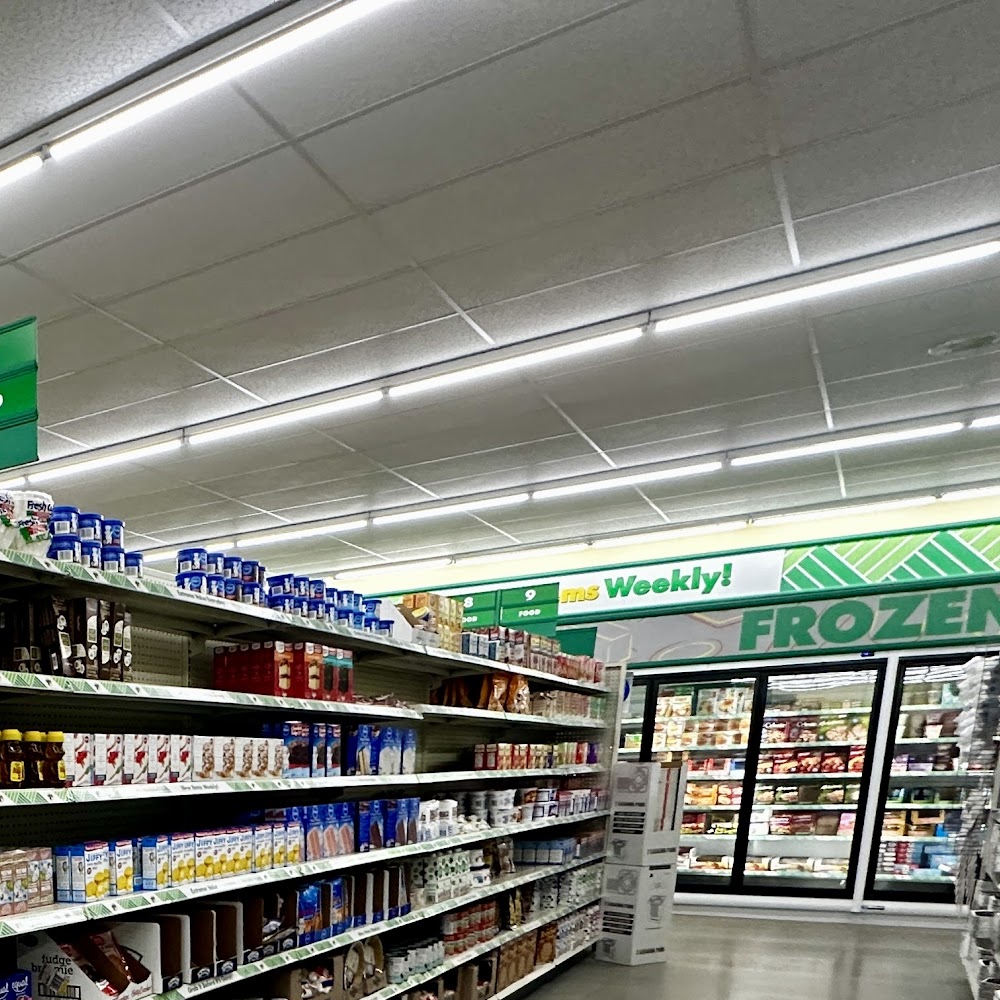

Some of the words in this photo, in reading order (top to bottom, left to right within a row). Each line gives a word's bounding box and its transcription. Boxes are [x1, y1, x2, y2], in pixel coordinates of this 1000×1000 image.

[604, 563, 733, 598] Weekly!
[525, 589, 536, 601] 9
[464, 596, 474, 608] 8
[518, 608, 541, 617] FOOD
[86, 853, 102, 862] JIFFY
[42, 954, 71, 966] fudge
[31, 962, 74, 975] brnie
